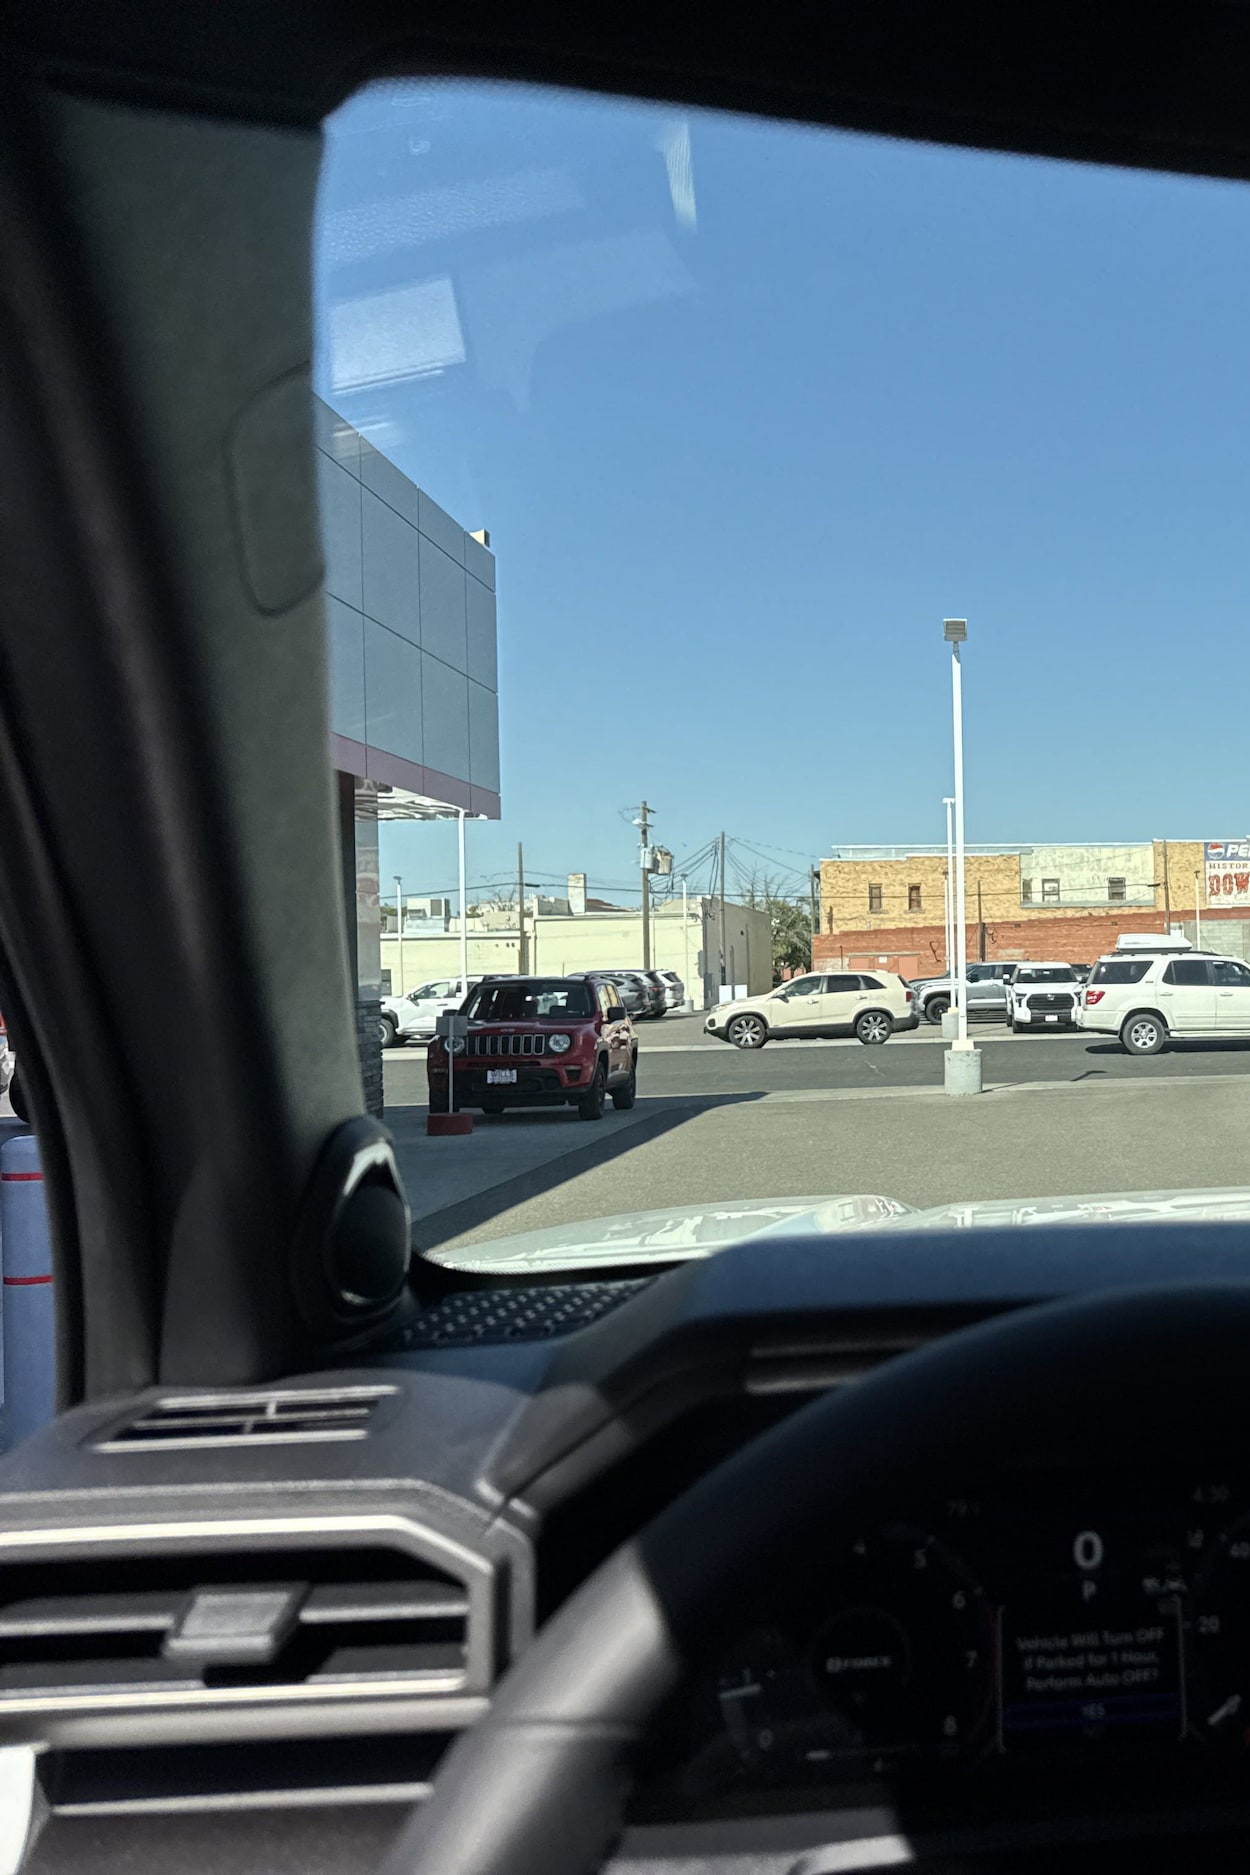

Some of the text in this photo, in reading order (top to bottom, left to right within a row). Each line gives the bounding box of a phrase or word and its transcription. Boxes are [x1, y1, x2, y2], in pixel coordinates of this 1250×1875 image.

[1073, 1530, 1104, 1570] 0
[1199, 1615, 1220, 1634] 20
[1016, 1626, 1165, 1650] Vehicle Will Turn OFF
[1036, 1653, 1085, 1669] Parked
[1087, 1652, 1108, 1665] for
[1026, 1667, 1160, 1692] Perform Auto OFF?
[1081, 1702, 1106, 1719] YES
